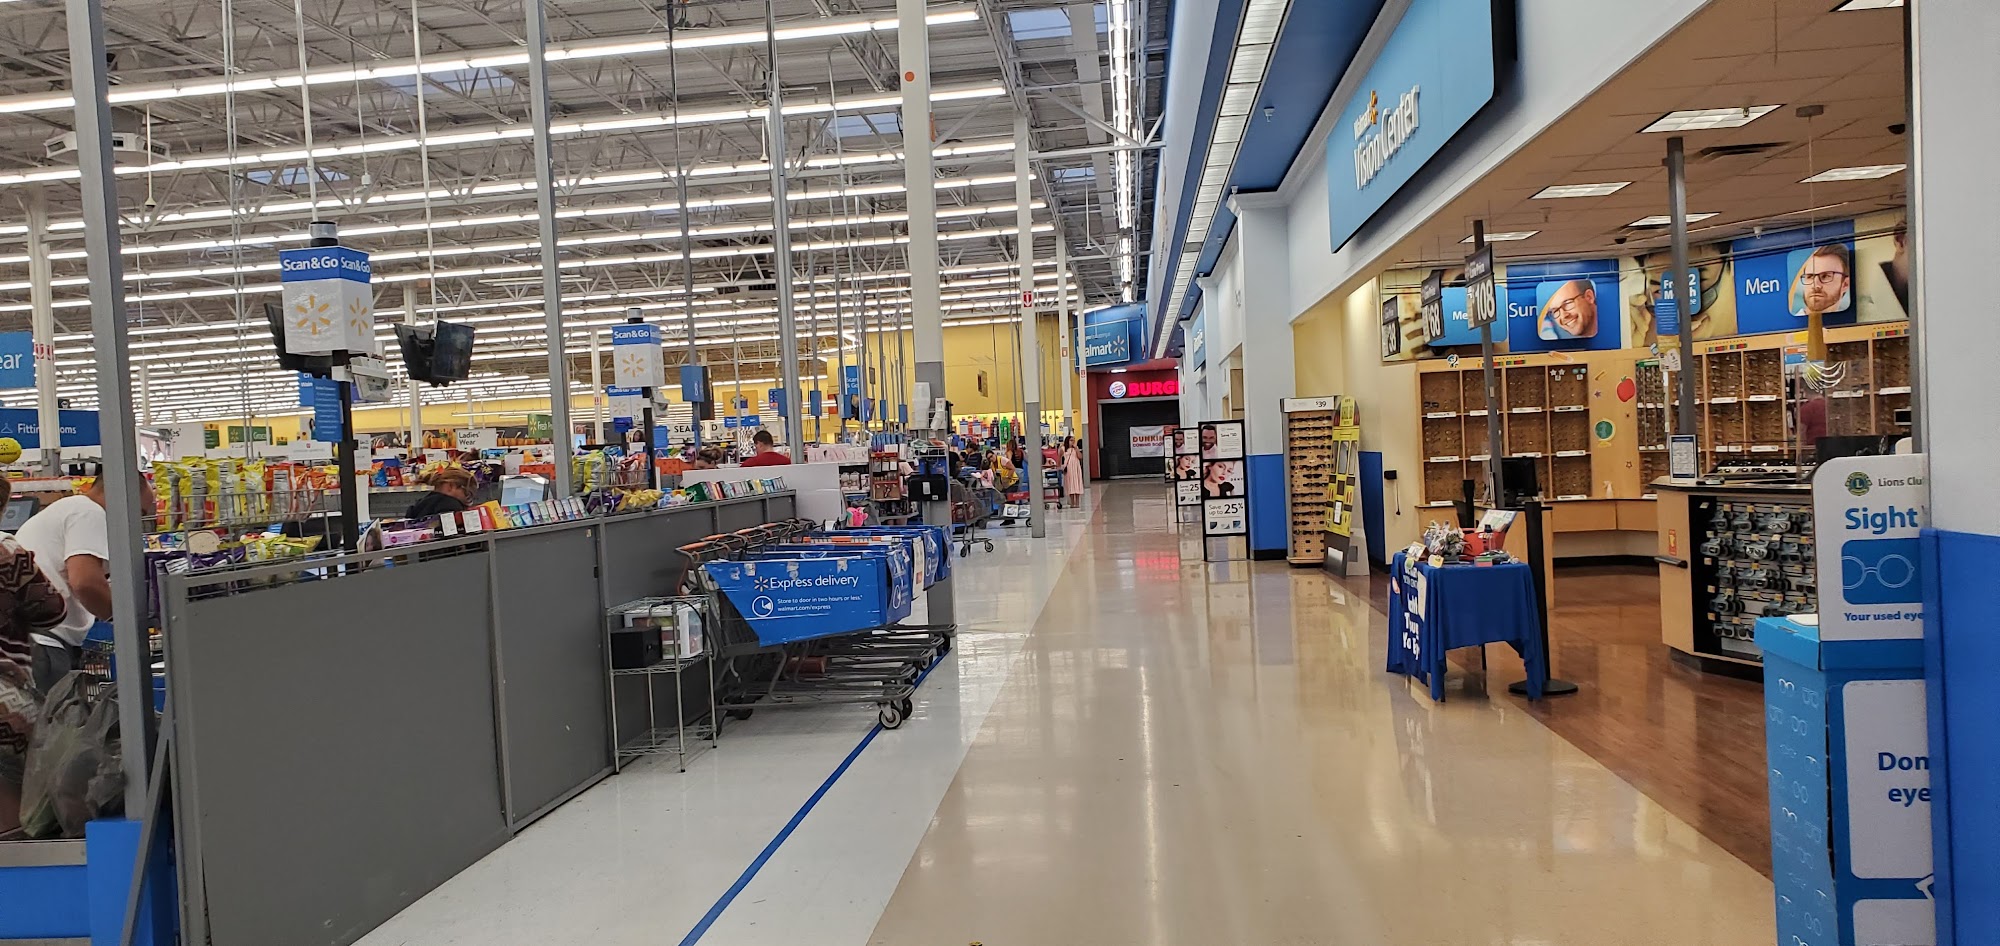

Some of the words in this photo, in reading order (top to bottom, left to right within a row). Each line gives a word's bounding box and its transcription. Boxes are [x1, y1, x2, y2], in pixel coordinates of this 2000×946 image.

[1353, 133, 1384, 190] Vision
[1381, 85, 1420, 160] Center
[1745, 277, 1780, 296] Men
[1452, 310, 1468, 320] Me
[1508, 303, 1538, 318] Sun
[1077, 341, 1112, 358] almart
[18, 423, 39, 434] Fittin
[60, 426, 77, 434] oms
[674, 424, 718, 433] SEAD
[1189, 483, 1199, 491] 25
[1878, 478, 1905, 487] Lions
[1907, 477, 1923, 486] Clu
[1845, 506, 1918, 535] Sight
[770, 576, 813, 591] Express
[814, 574, 859, 588] delivery
[777, 604, 831, 612] walmart.com/express
[1843, 612, 1871, 621] Your
[1873, 611, 1901, 621] used
[1904, 612, 1924, 624] eye
[1878, 752, 1929, 771] Don
[1888, 788, 1931, 808] eye
